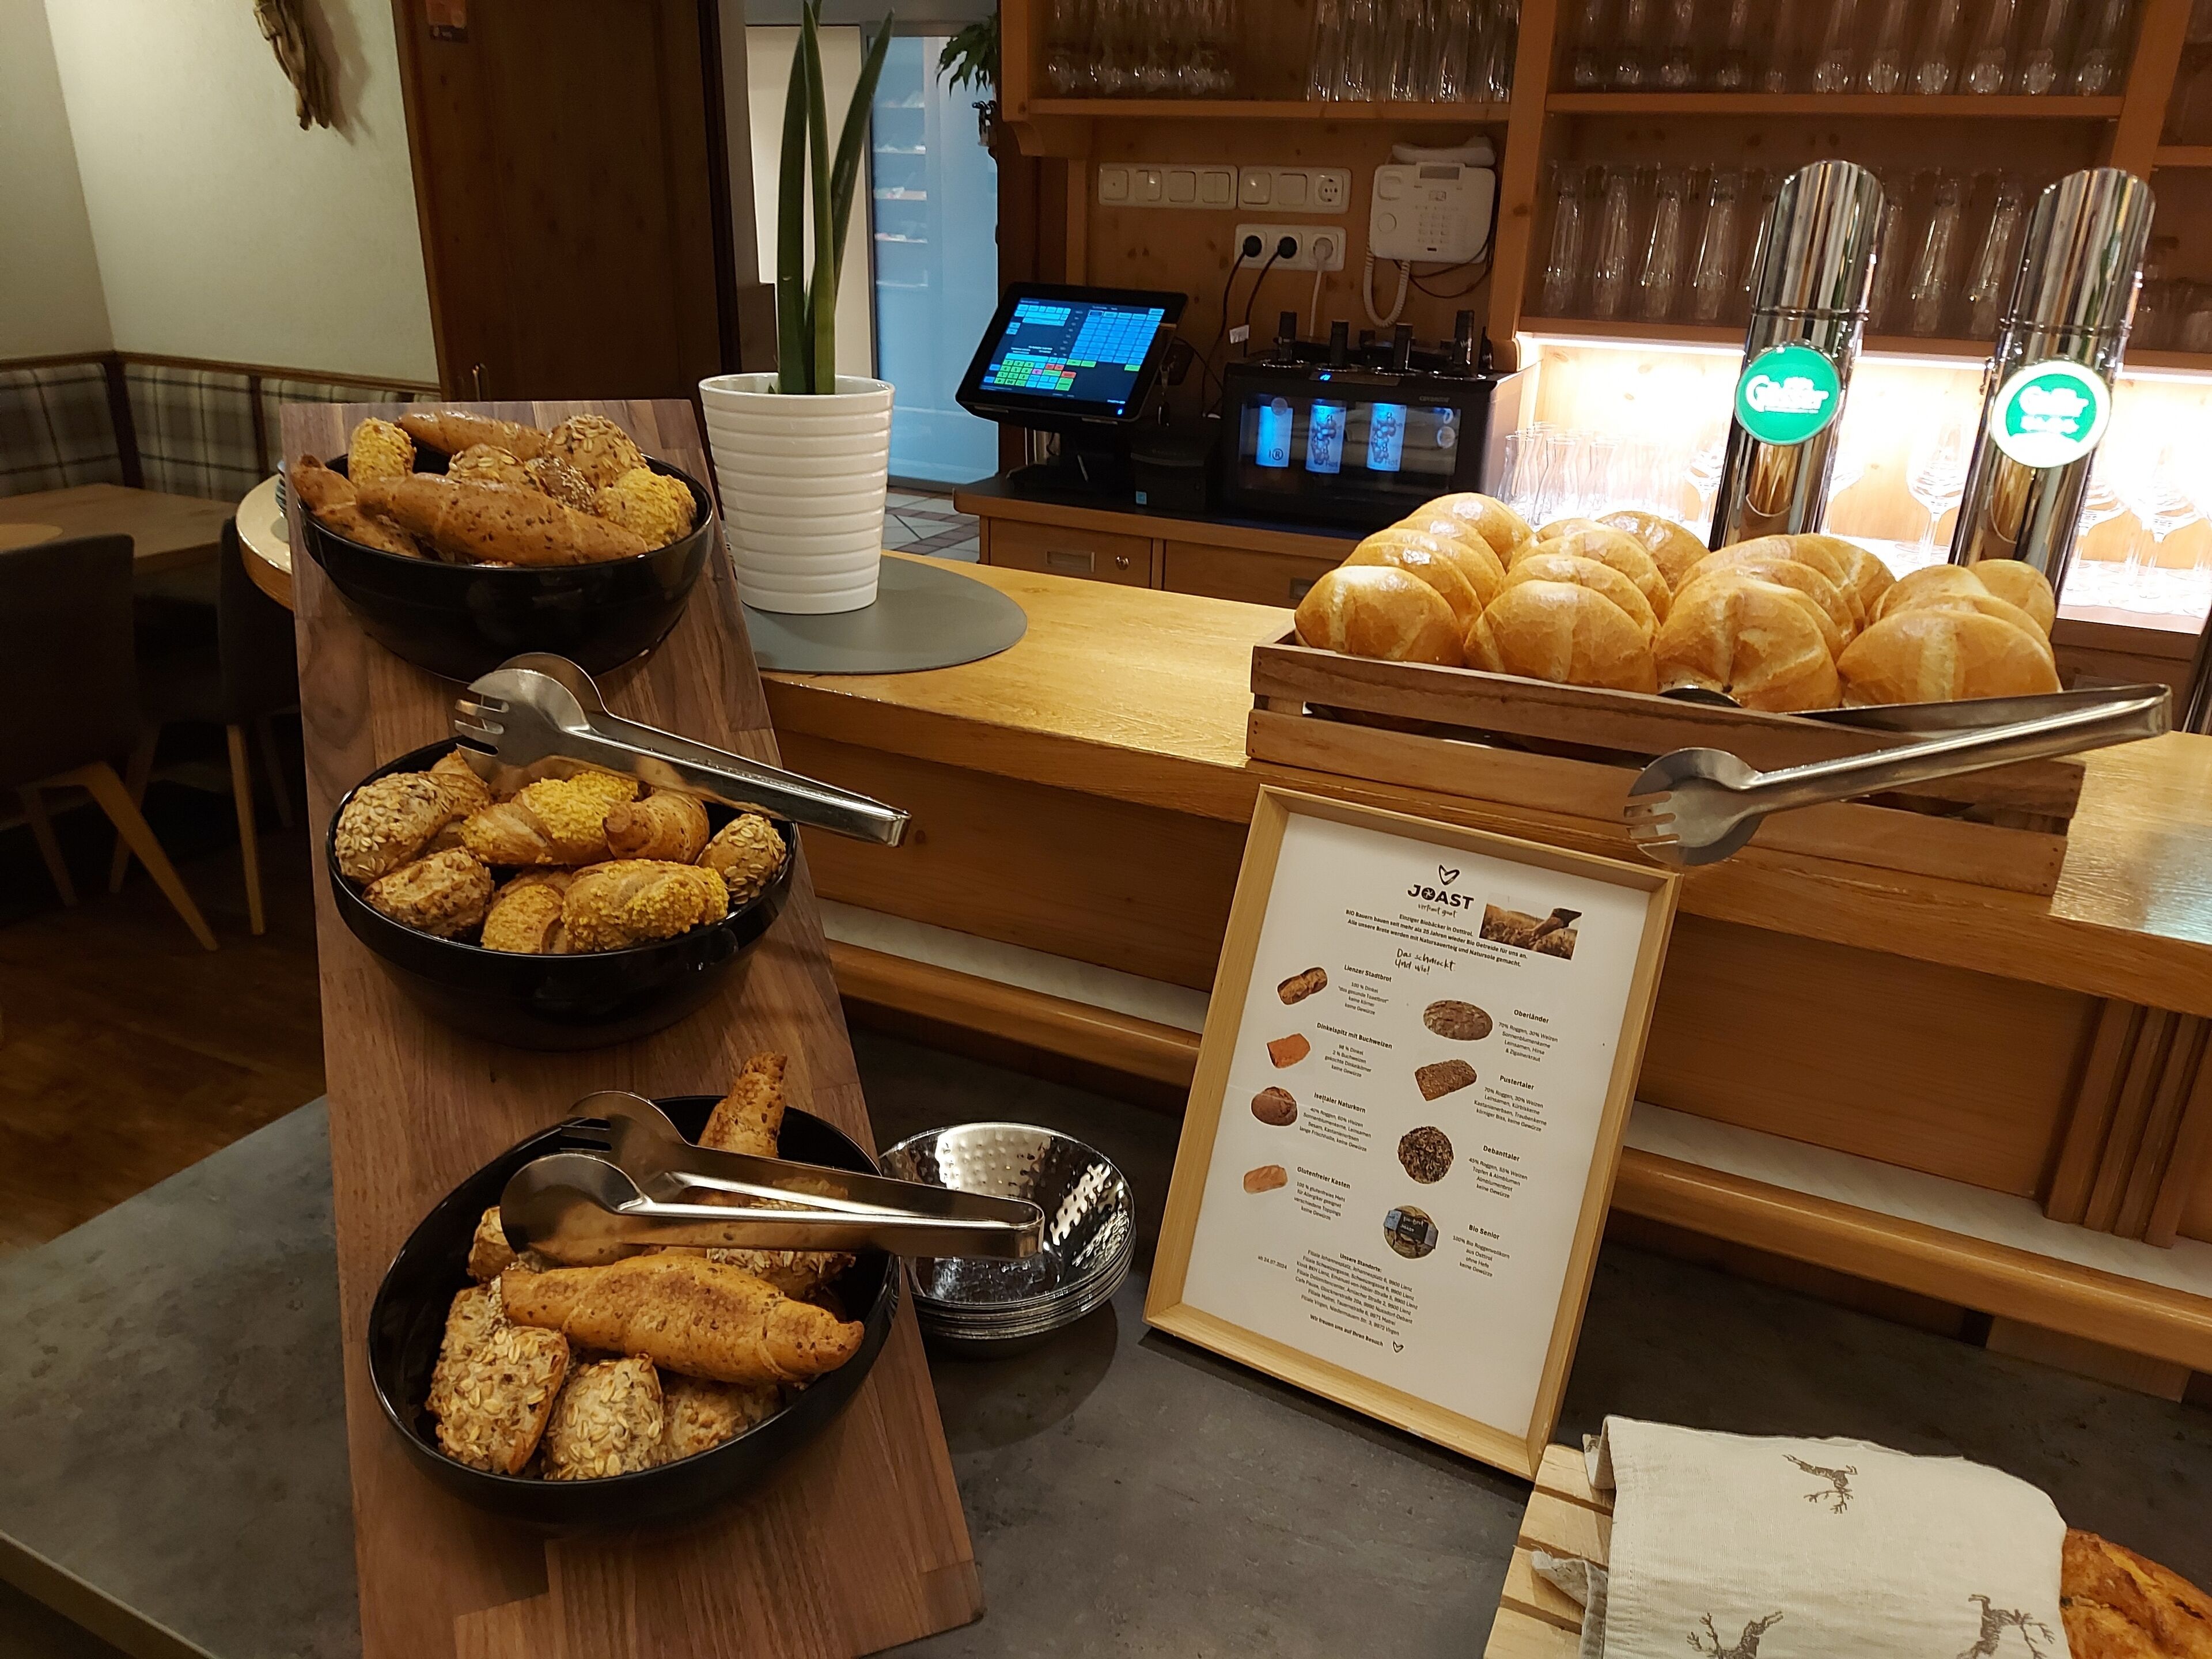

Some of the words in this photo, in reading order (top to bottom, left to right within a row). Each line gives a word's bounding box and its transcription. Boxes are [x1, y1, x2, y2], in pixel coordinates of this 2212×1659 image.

[1407, 884, 1474, 910] JOAST
[1355, 911, 1373, 921] Bauern
[1373, 916, 1389, 925] bauen
[1430, 930, 1447, 939] Jahren
[1476, 942, 1499, 952] Getreide
[1399, 914, 1419, 923] Einziger
[1420, 919, 1446, 930] Biobäcker
[1452, 927, 1474, 937] Osttirol.
[1358, 922, 1376, 930] unsere
[1376, 926, 1389, 934] Brote
[1390, 930, 1409, 938] werden
[1419, 937, 1457, 952] Natursauerteig
[1469, 949, 1495, 960] Natursole
[1495, 957, 1521, 967] gemacht.
[1397, 948, 1411, 957] Das
[1344, 964, 1365, 975] Lienzer
[1365, 970, 1392, 982] Stadtbrot
[1395, 959, 1412, 969] Und
[1414, 964, 1430, 975] wie!
[1514, 1009, 1549, 1024] Oberländer
[1317, 1022, 1347, 1036] Dinkelspitz
[1358, 1034, 1392, 1050] Buchweizen
[1502, 1031, 1551, 1048] Sonnenblumenkerne
[1540, 1033, 1558, 1042] Weizen
[1499, 1075, 1534, 1090] Pustertaler
[1338, 1100, 1366, 1113] Naturkorn
[1526, 1099, 1543, 1108] Weizen
[1515, 1112, 1547, 1126] Traubenkerne
[1521, 1122, 1541, 1132] Gewürze
[1483, 1145, 1520, 1161] Debanttaler
[1297, 1166, 1331, 1182] Glutenfreier
[1331, 1177, 1350, 1189] Kasten
[1510, 1170, 1528, 1180] Weizen
[1476, 1183, 1489, 1192] keine
[1489, 1188, 1510, 1198] Gewürze
[1469, 1224, 1479, 1233] Bio
[1479, 1228, 1499, 1240] Senior
[1340, 1253, 1357, 1263] Unsere
[1475, 1251, 1493, 1262] Osttirol
